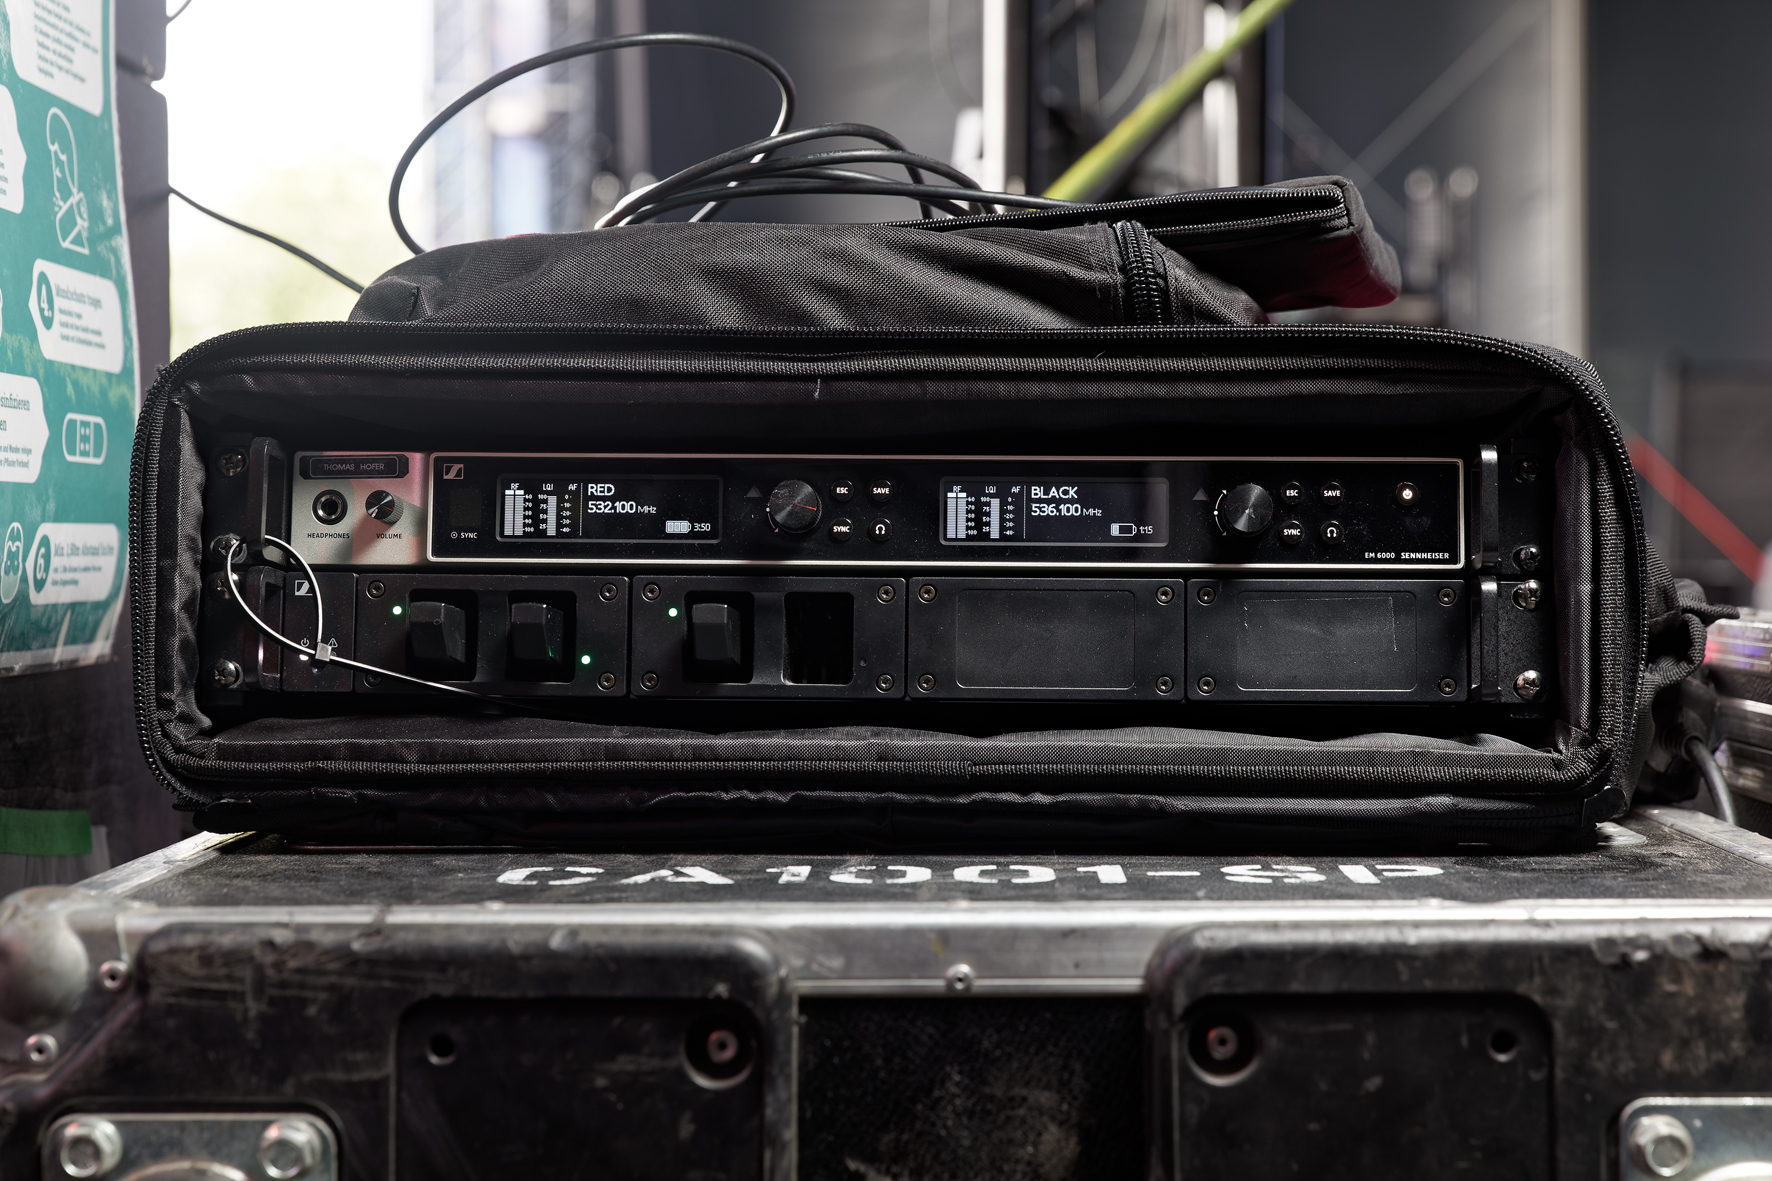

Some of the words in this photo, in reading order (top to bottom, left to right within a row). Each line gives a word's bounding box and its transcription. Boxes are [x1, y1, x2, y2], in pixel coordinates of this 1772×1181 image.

[40, 284, 52, 317] 4.
[323, 463, 355, 471] THOMAS
[360, 463, 385, 471] HOFER
[543, 483, 554, 491] LQI
[587, 484, 615, 496] RED
[1031, 486, 1078, 499] BLACK
[1286, 489, 1299, 497] ESC
[1323, 489, 1341, 497] SAVE
[587, 501, 636, 513] 532.100
[637, 505, 657, 513] MHz
[1031, 504, 1081, 516] 536.100
[1083, 508, 1102, 516] MHz
[693, 523, 711, 531] 3:50
[833, 525, 850, 533] SYNC
[376, 532, 403, 540] VOLUME
[1283, 528, 1301, 536] SYNC
[36, 547, 46, 580] 6.
